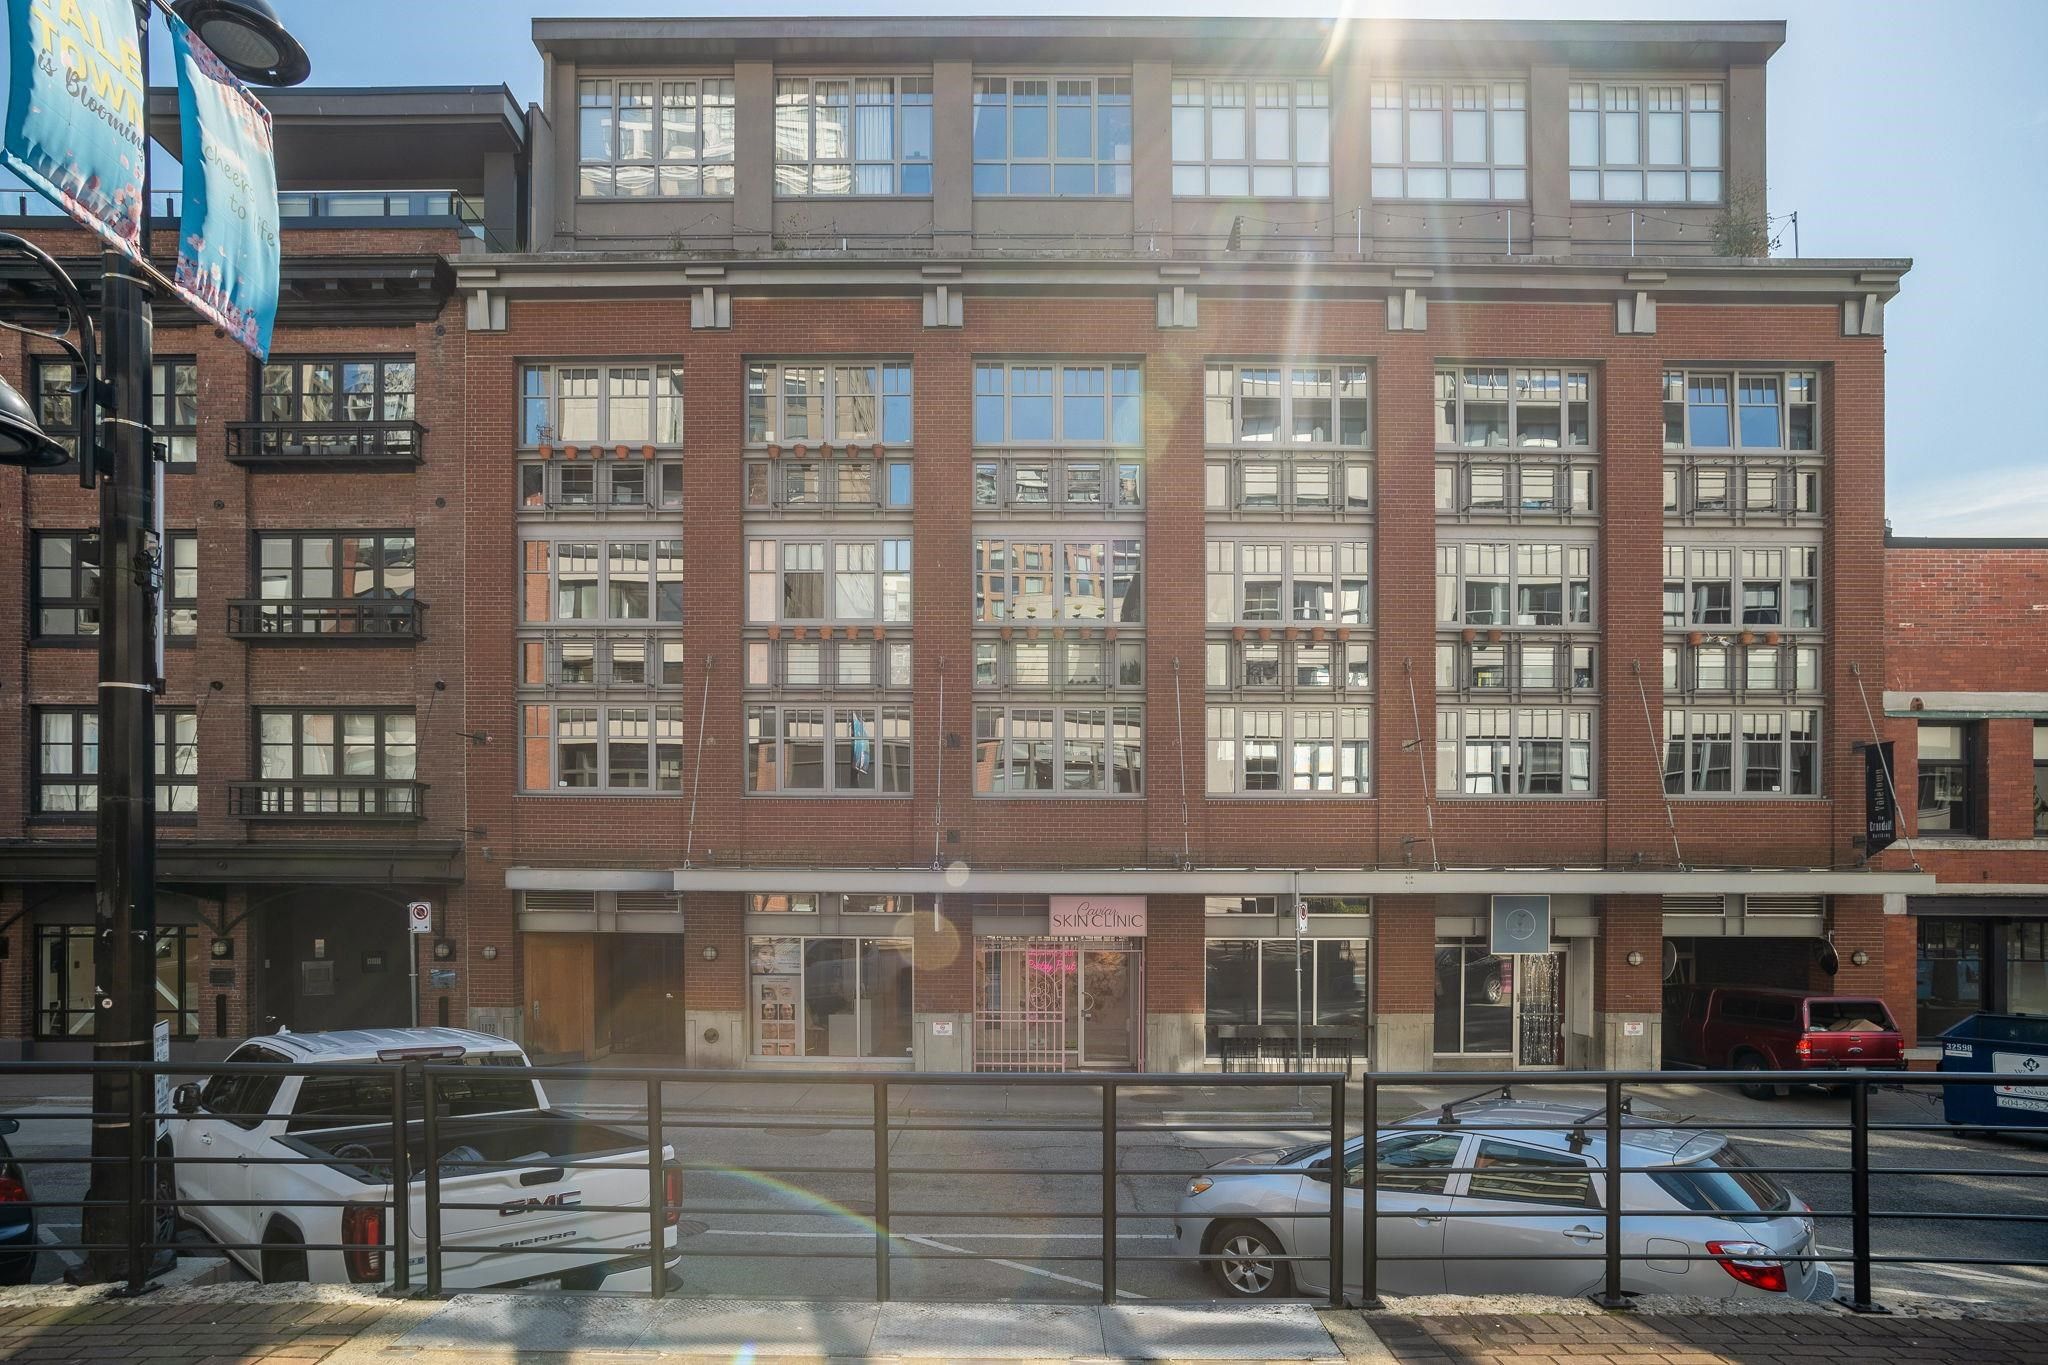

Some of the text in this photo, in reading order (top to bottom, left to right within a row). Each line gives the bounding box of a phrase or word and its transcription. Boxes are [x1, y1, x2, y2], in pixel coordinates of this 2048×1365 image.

[42, 0, 143, 91] ALE
[230, 193, 275, 247] to life
[1053, 914, 1144, 928] SKIN CLINIC
[1077, 902, 1118, 917] Caviar
[499, 1190, 581, 1217] GMC
